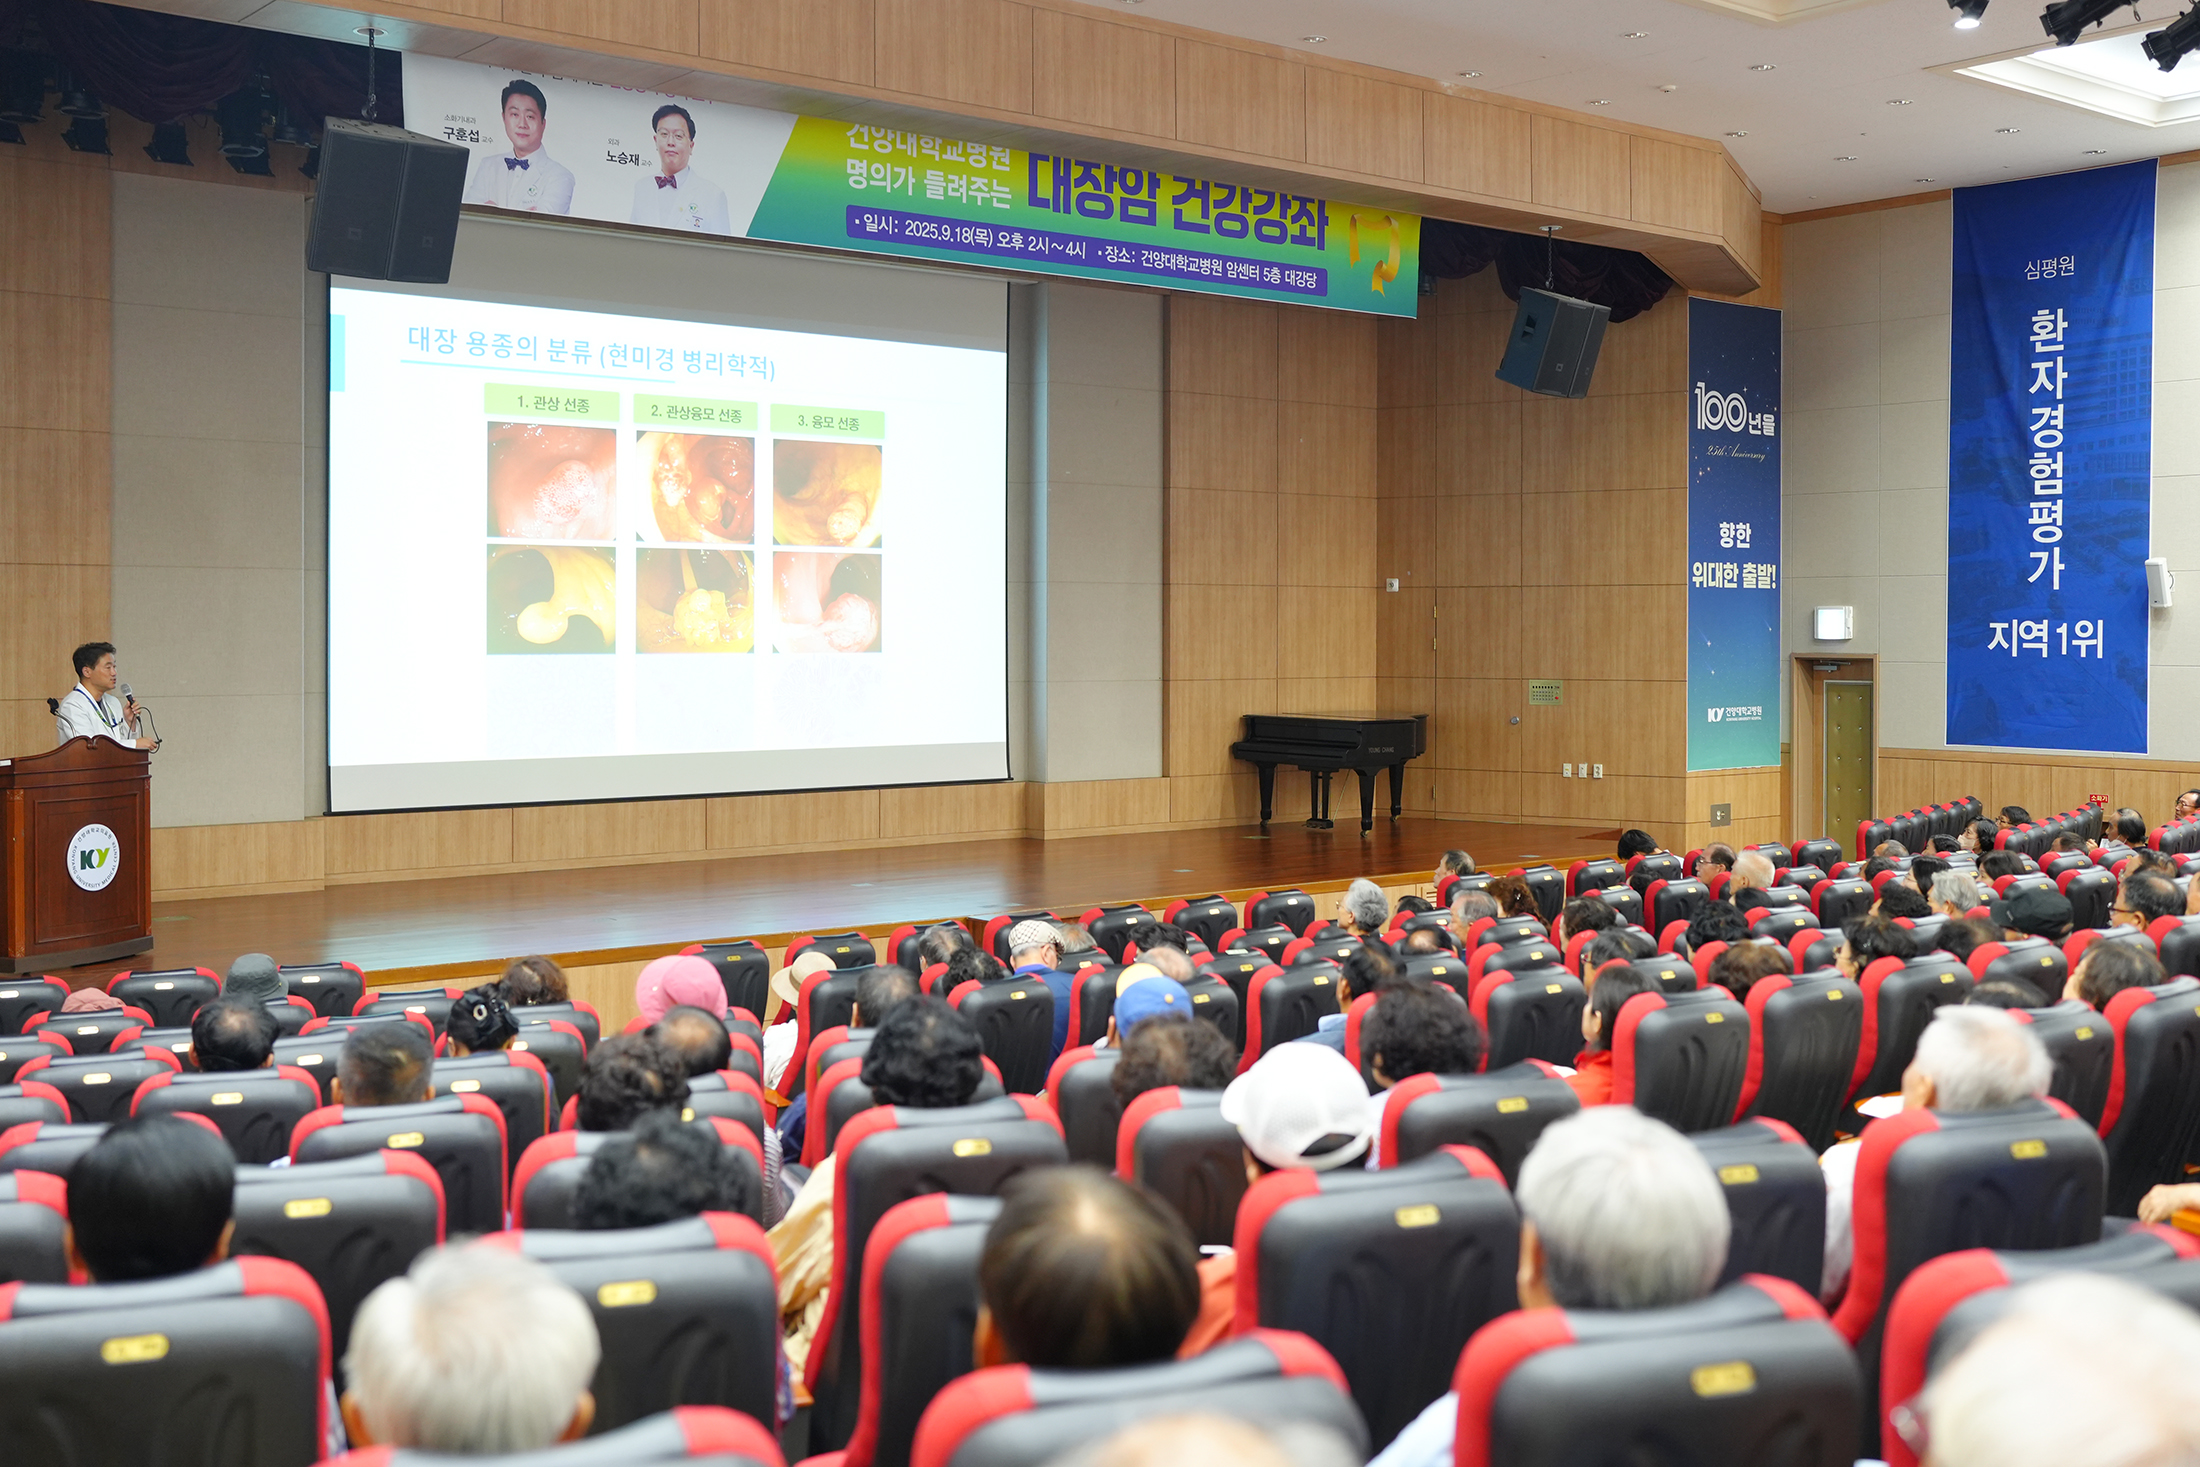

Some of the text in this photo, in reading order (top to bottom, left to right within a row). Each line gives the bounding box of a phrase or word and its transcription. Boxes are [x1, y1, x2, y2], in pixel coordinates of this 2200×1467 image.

[444, 114, 477, 125] 소화기내과
[443, 126, 494, 145] 구훈섭 교수
[606, 150, 653, 167] 노승재 교수
[846, 158, 1012, 209] 명의가 들려주는
[1028, 152, 1329, 251] 대장암 건강강좌
[863, 213, 898, 235] 일시:
[904, 219, 994, 248] 2025.9.18(목)
[996, 231, 1025, 251] 오후
[1104, 245, 1136, 263] 장소:
[1141, 250, 1223, 276] 건양대학교병원
[1226, 261, 1260, 282] 암센터
[1263, 267, 1282, 285] 5층
[1284, 270, 1318, 289] 대강당
[2024, 255, 2075, 281] 심평원
[408, 326, 775, 382] 대장 용종의 분류 (현미경 병리학적)
[517, 395, 590, 414] 1. 관상 선종
[651, 404, 743, 424] 2. 관상융모 선종
[798, 415, 860, 432] 3. 융모 선종
[2027, 308, 2069, 590] 환자경험평가
[1719, 521, 1752, 549] 향한
[1692, 561, 1777, 589] 위대한 출발!
[1987, 619, 2104, 659] 지역 1위
[1725, 706, 1762, 717] 건양대학교병원
[80, 847, 111, 871] KY
[75, 874, 101, 888] UNIVERSITY
